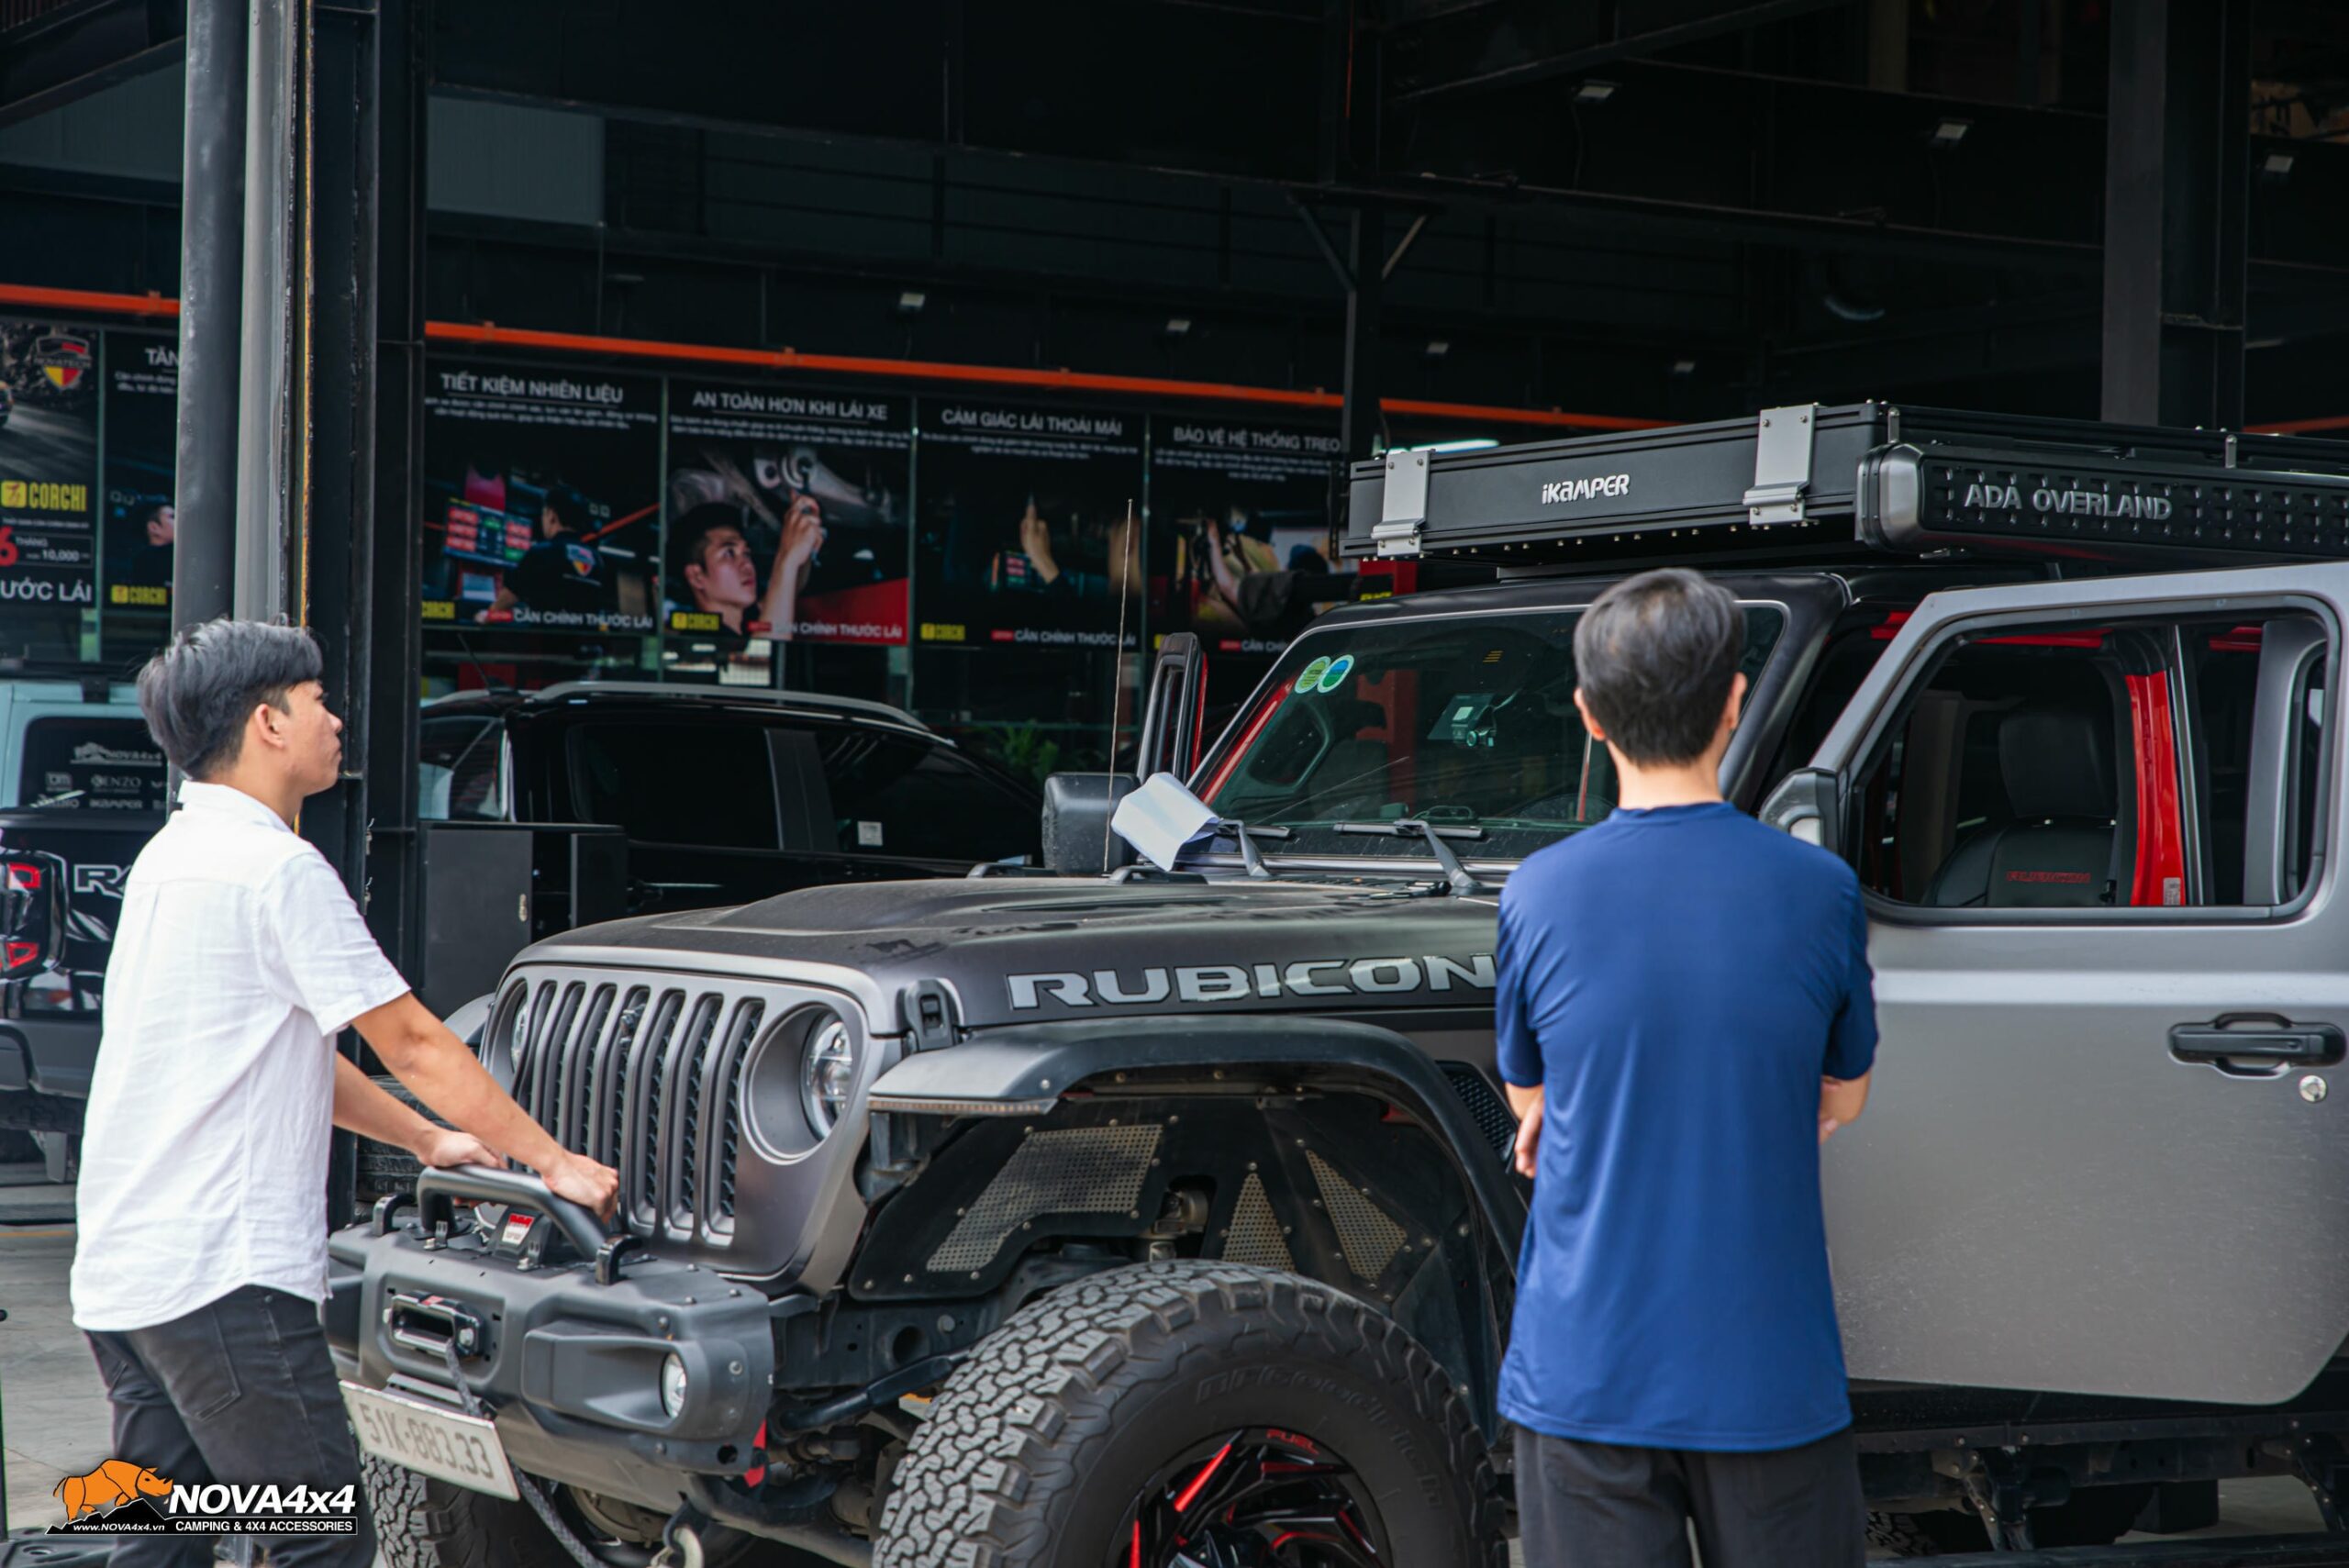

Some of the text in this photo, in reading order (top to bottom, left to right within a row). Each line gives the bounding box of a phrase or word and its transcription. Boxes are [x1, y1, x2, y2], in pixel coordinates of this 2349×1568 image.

[441, 371, 623, 404] TIẾT KIỆM NHIÊN LIỆU
[693, 392, 717, 406] AN
[808, 401, 836, 416] KHI
[867, 405, 888, 420] XE
[1303, 436, 1341, 452] TREO
[1964, 484, 2172, 520] ADA OVERLAND
[59, 579, 92, 602] LÁI
[1008, 953, 1497, 1009] RUBICON
